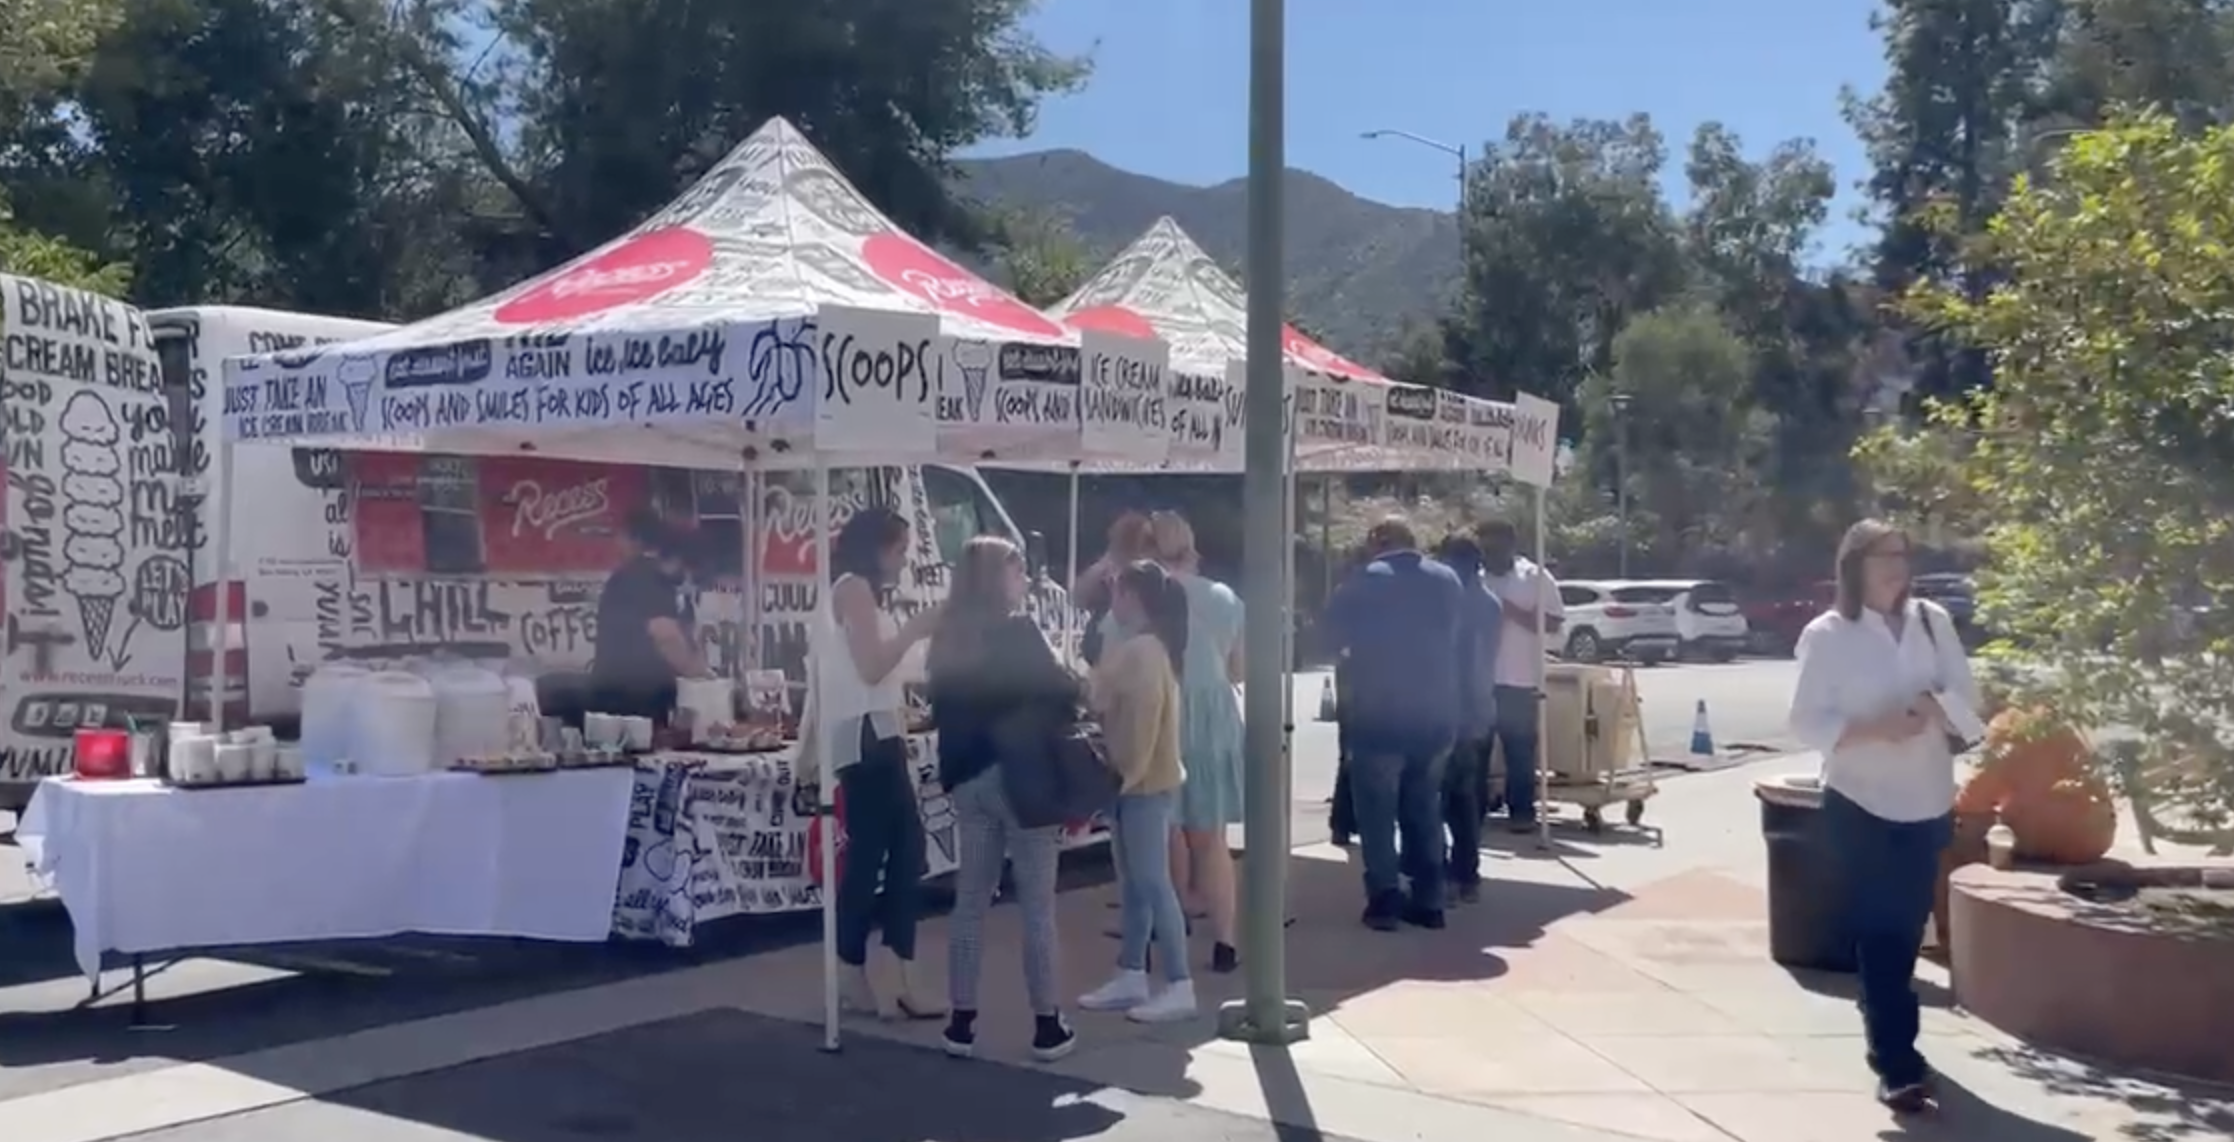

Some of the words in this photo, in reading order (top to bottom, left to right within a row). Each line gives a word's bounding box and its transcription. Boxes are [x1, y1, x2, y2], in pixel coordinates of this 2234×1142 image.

[17, 280, 118, 345] BRAKE
[6, 333, 97, 384] CREAM
[505, 349, 570, 379] AGAIN
[822, 332, 930, 404] SCOOPS
[1090, 351, 1111, 389] ICE
[1115, 354, 1162, 392] CREAM
[223, 386, 259, 414] JUST
[264, 375, 300, 411] TAKE
[304, 374, 327, 410] AN
[381, 391, 430, 431] SCOOPS
[435, 391, 471, 427] AND
[475, 386, 529, 424] SMILES
[536, 384, 571, 424] FOR
[575, 381, 611, 420] KIDS
[617, 380, 646, 421] OF
[646, 381, 681, 417] ALL
[685, 376, 735, 416] AGES
[502, 476, 610, 541] Recess
[629, 783, 656, 830] PLAY
